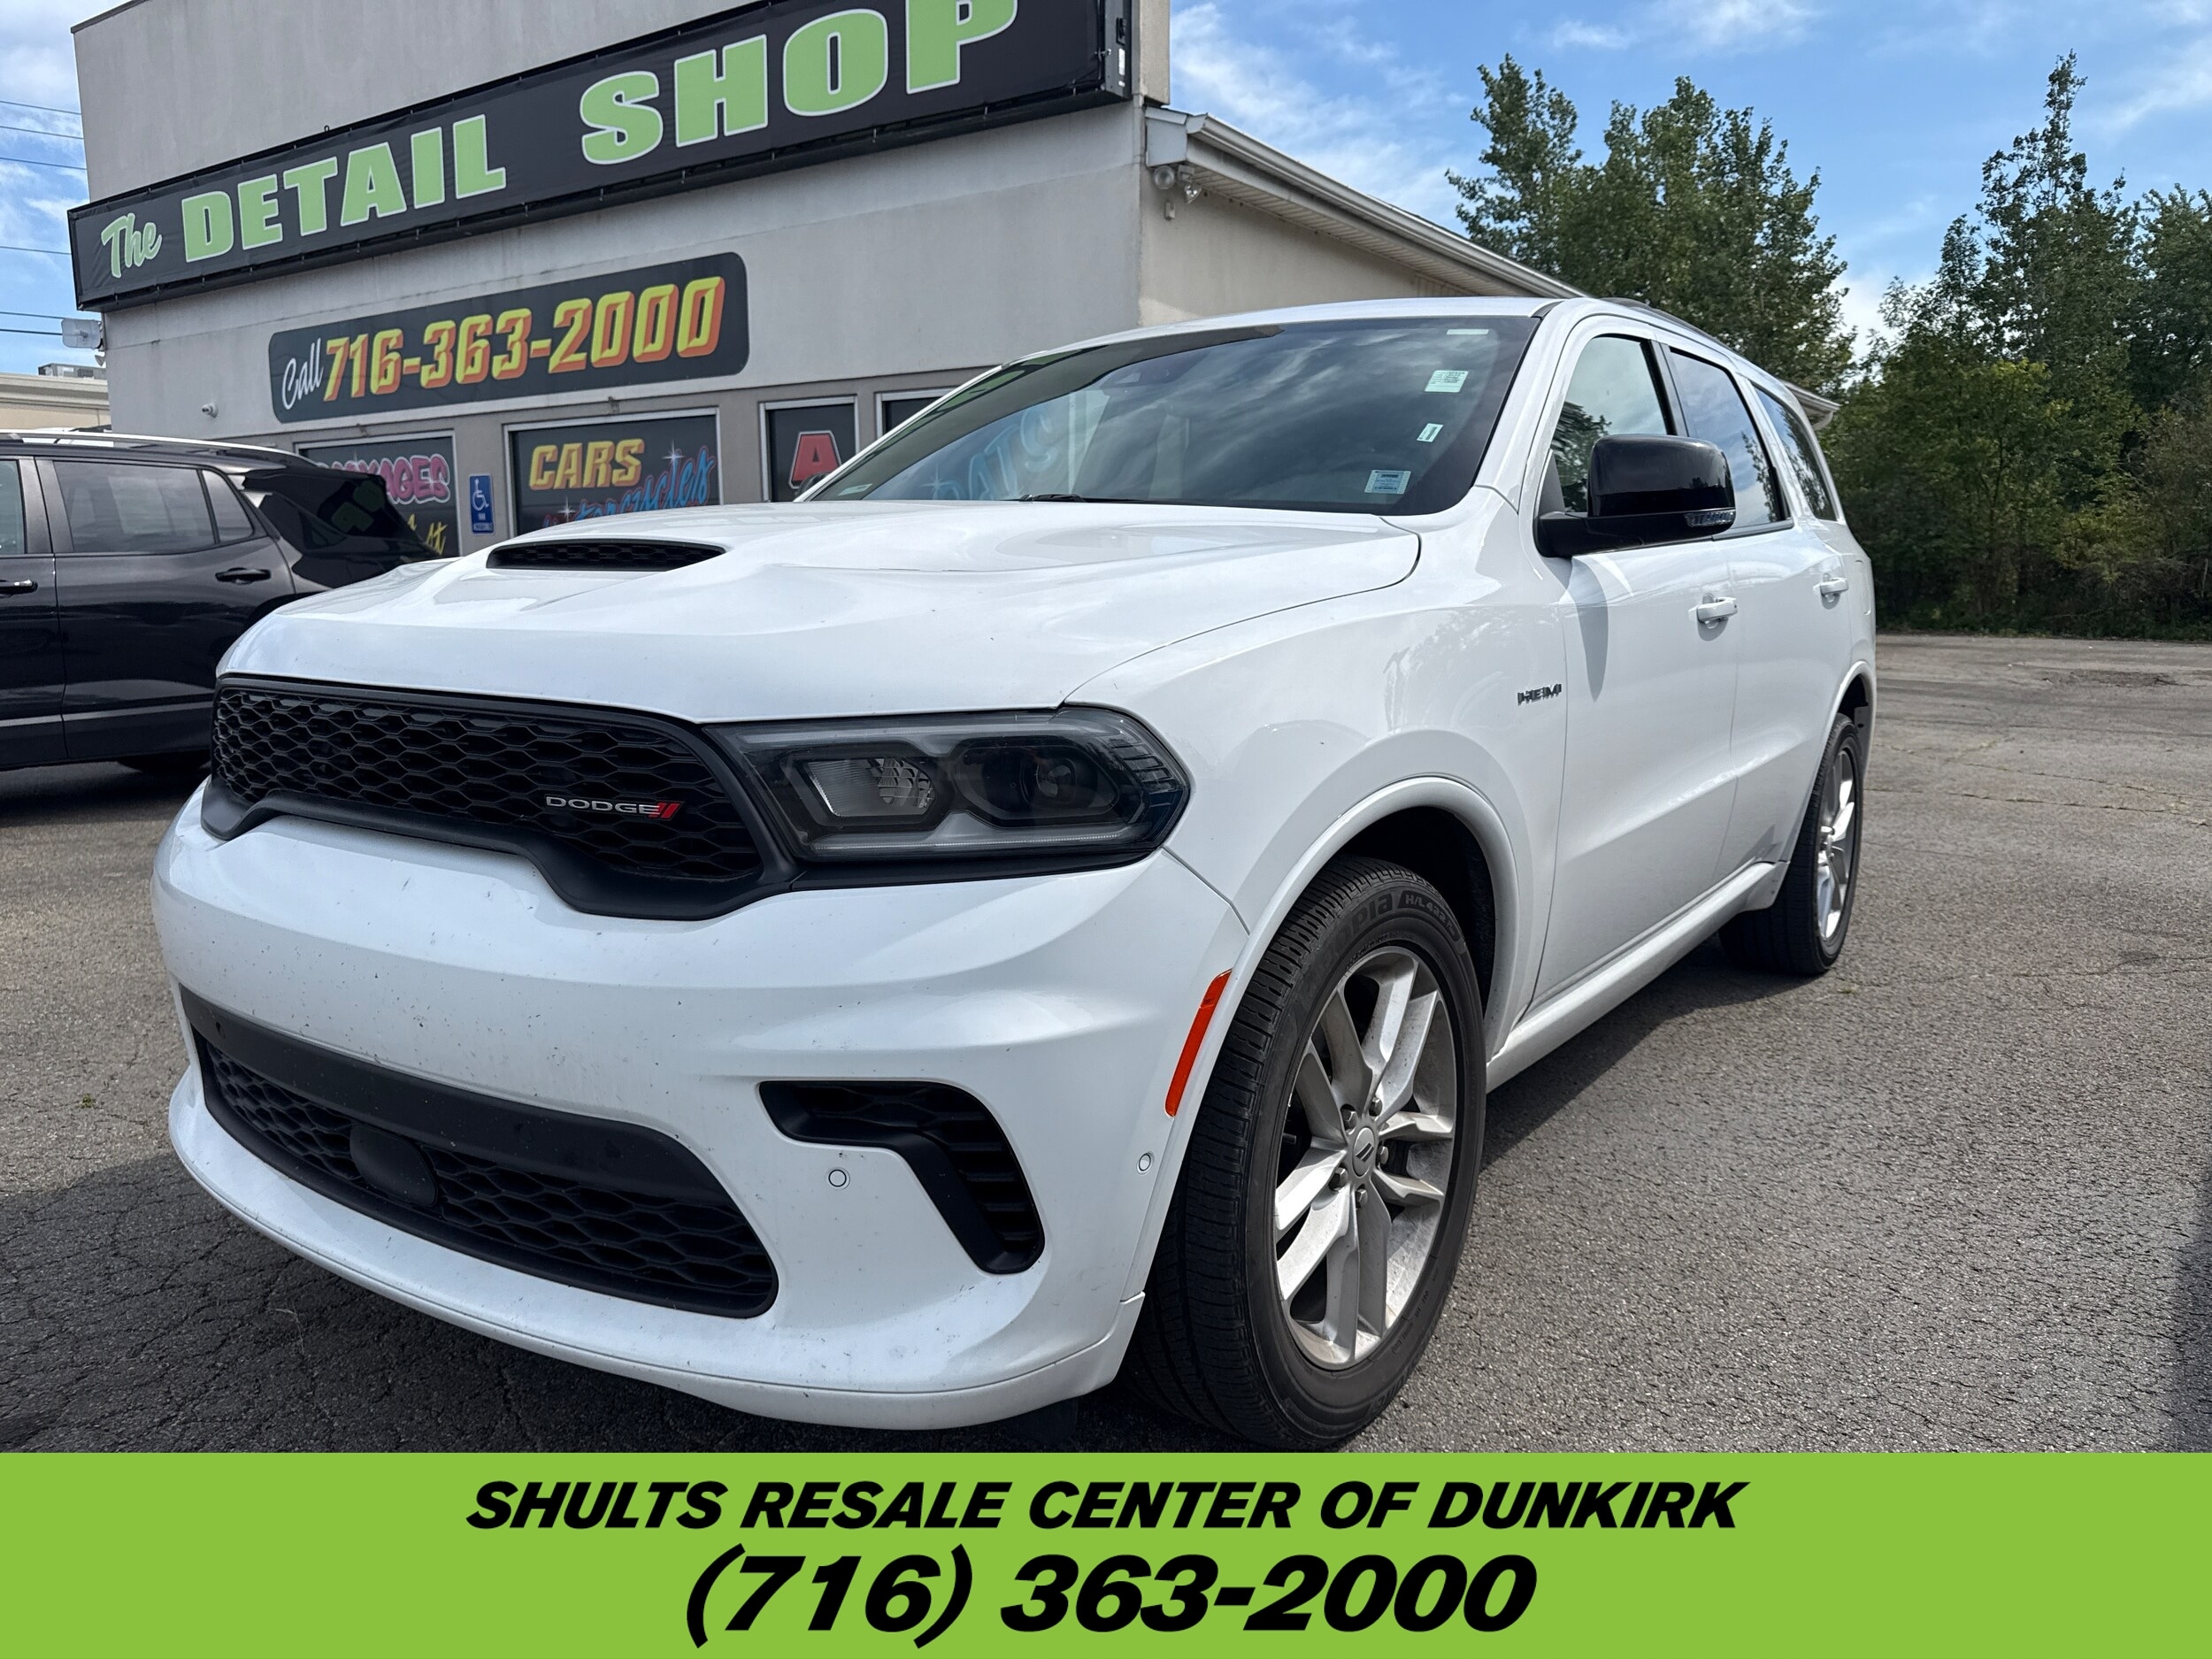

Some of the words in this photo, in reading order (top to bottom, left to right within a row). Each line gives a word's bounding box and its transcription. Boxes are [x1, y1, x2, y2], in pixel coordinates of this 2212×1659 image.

[102, 212, 162, 278] The
[181, 114, 507, 263] DETAIL
[580, 0, 1018, 165] SHOP
[281, 338, 325, 411] Call
[323, 276, 726, 403] 716-363-2000
[529, 438, 645, 491] CARS
[546, 796, 662, 815] DODGE
